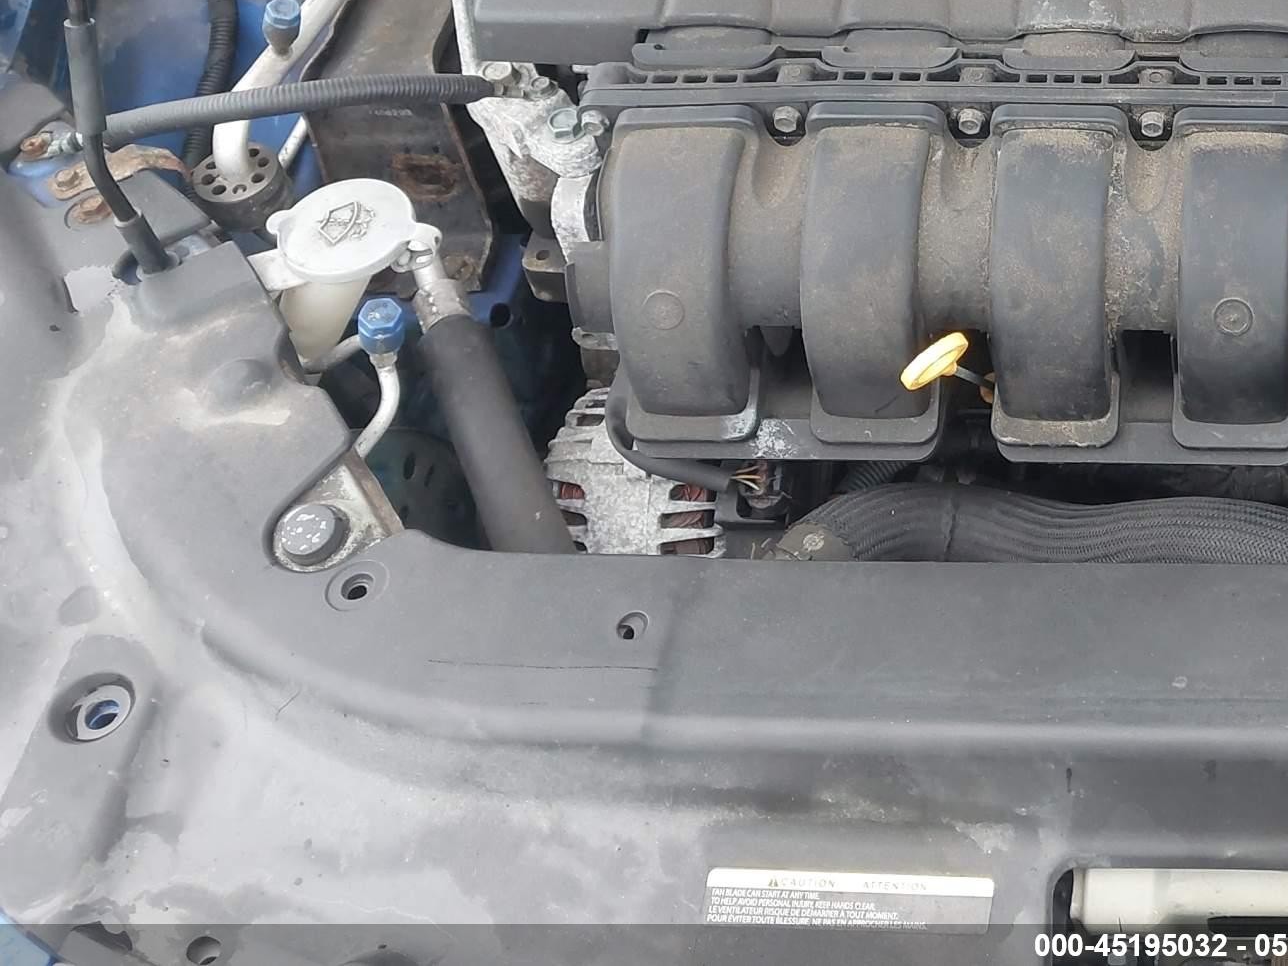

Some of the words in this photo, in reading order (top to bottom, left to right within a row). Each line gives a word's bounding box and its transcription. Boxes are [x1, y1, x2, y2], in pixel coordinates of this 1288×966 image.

[781, 878, 836, 888] CAUTION
[864, 881, 927, 890] ATTENTION
[747, 889, 761, 897] CAN
[762, 890, 780, 898] START
[720, 897, 737, 905] HELP
[758, 898, 790, 907] PERSONAL
[717, 906, 763, 915] VENTILATEUR
[764, 907, 790, 916] RISQUE
[790, 908, 800, 916] DE
[846, 911, 864, 919] TOUT
[707, 914, 726, 922] POUR
